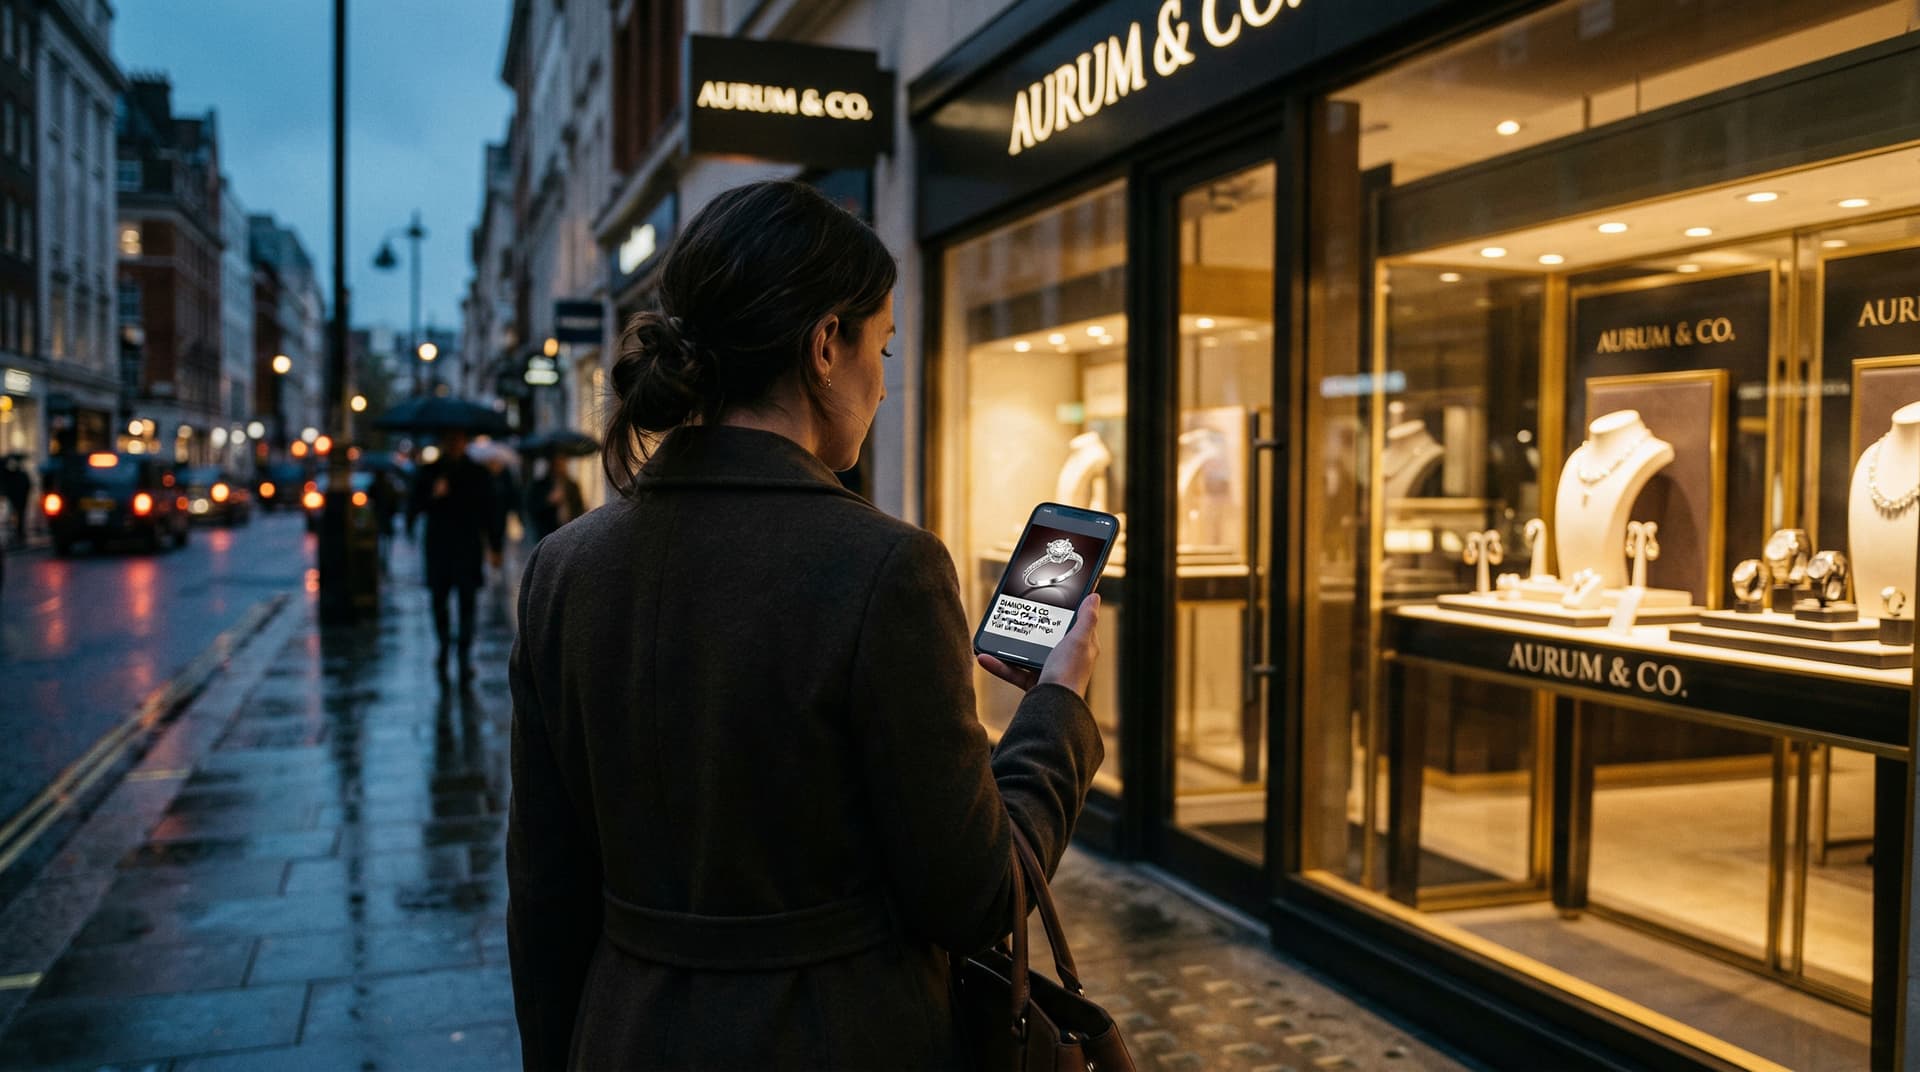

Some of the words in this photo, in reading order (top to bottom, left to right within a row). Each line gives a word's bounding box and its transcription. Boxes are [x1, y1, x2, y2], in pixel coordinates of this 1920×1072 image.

[1008, 21, 1147, 155] AURUM
[1153, 0, 1196, 76] &
[697, 80, 798, 115] AURUM
[800, 88, 825, 117] &
[825, 91, 873, 120] CO.
[1857, 296, 1920, 327] AUR
[1597, 325, 1671, 353] AURUM
[1675, 321, 1693, 346] &
[1696, 317, 1736, 343] CO.
[1508, 641, 1604, 683] AURUM
[1609, 656, 1631, 689] &
[1637, 661, 1688, 698] CO.
